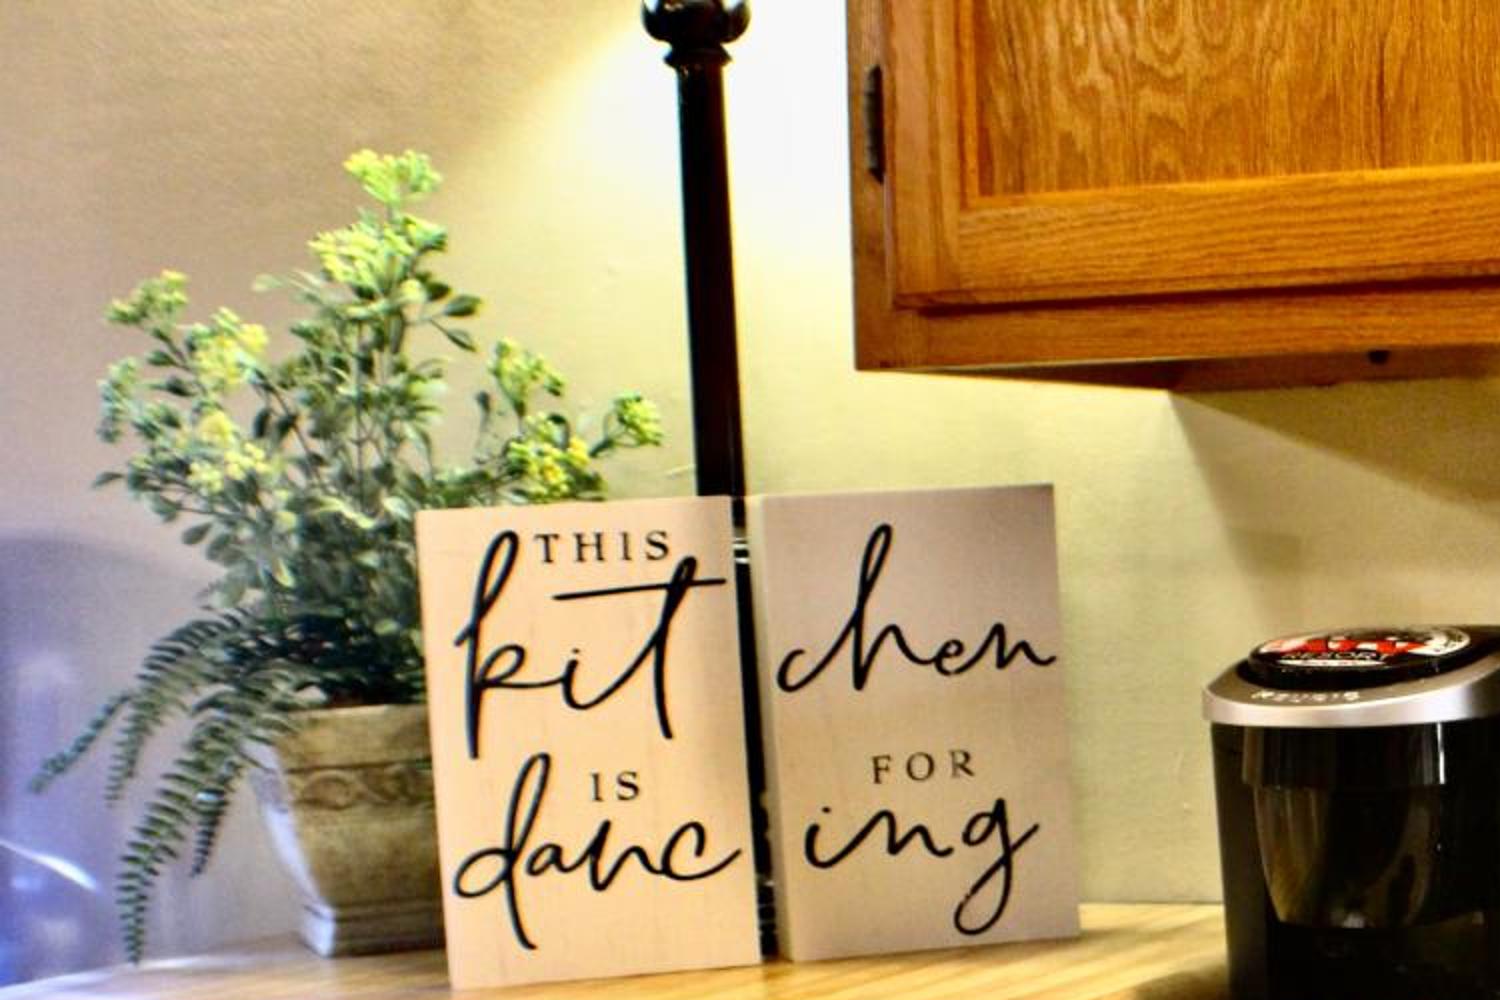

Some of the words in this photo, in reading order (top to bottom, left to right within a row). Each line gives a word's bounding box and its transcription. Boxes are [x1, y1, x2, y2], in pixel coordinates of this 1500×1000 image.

[533, 529, 673, 565] THIS
[775, 523, 1057, 693] chen
[454, 530, 727, 760] kit
[590, 771, 641, 803] IS
[872, 748, 976, 785] FOR
[453, 752, 742, 951] danc
[803, 796, 1039, 936] ing
